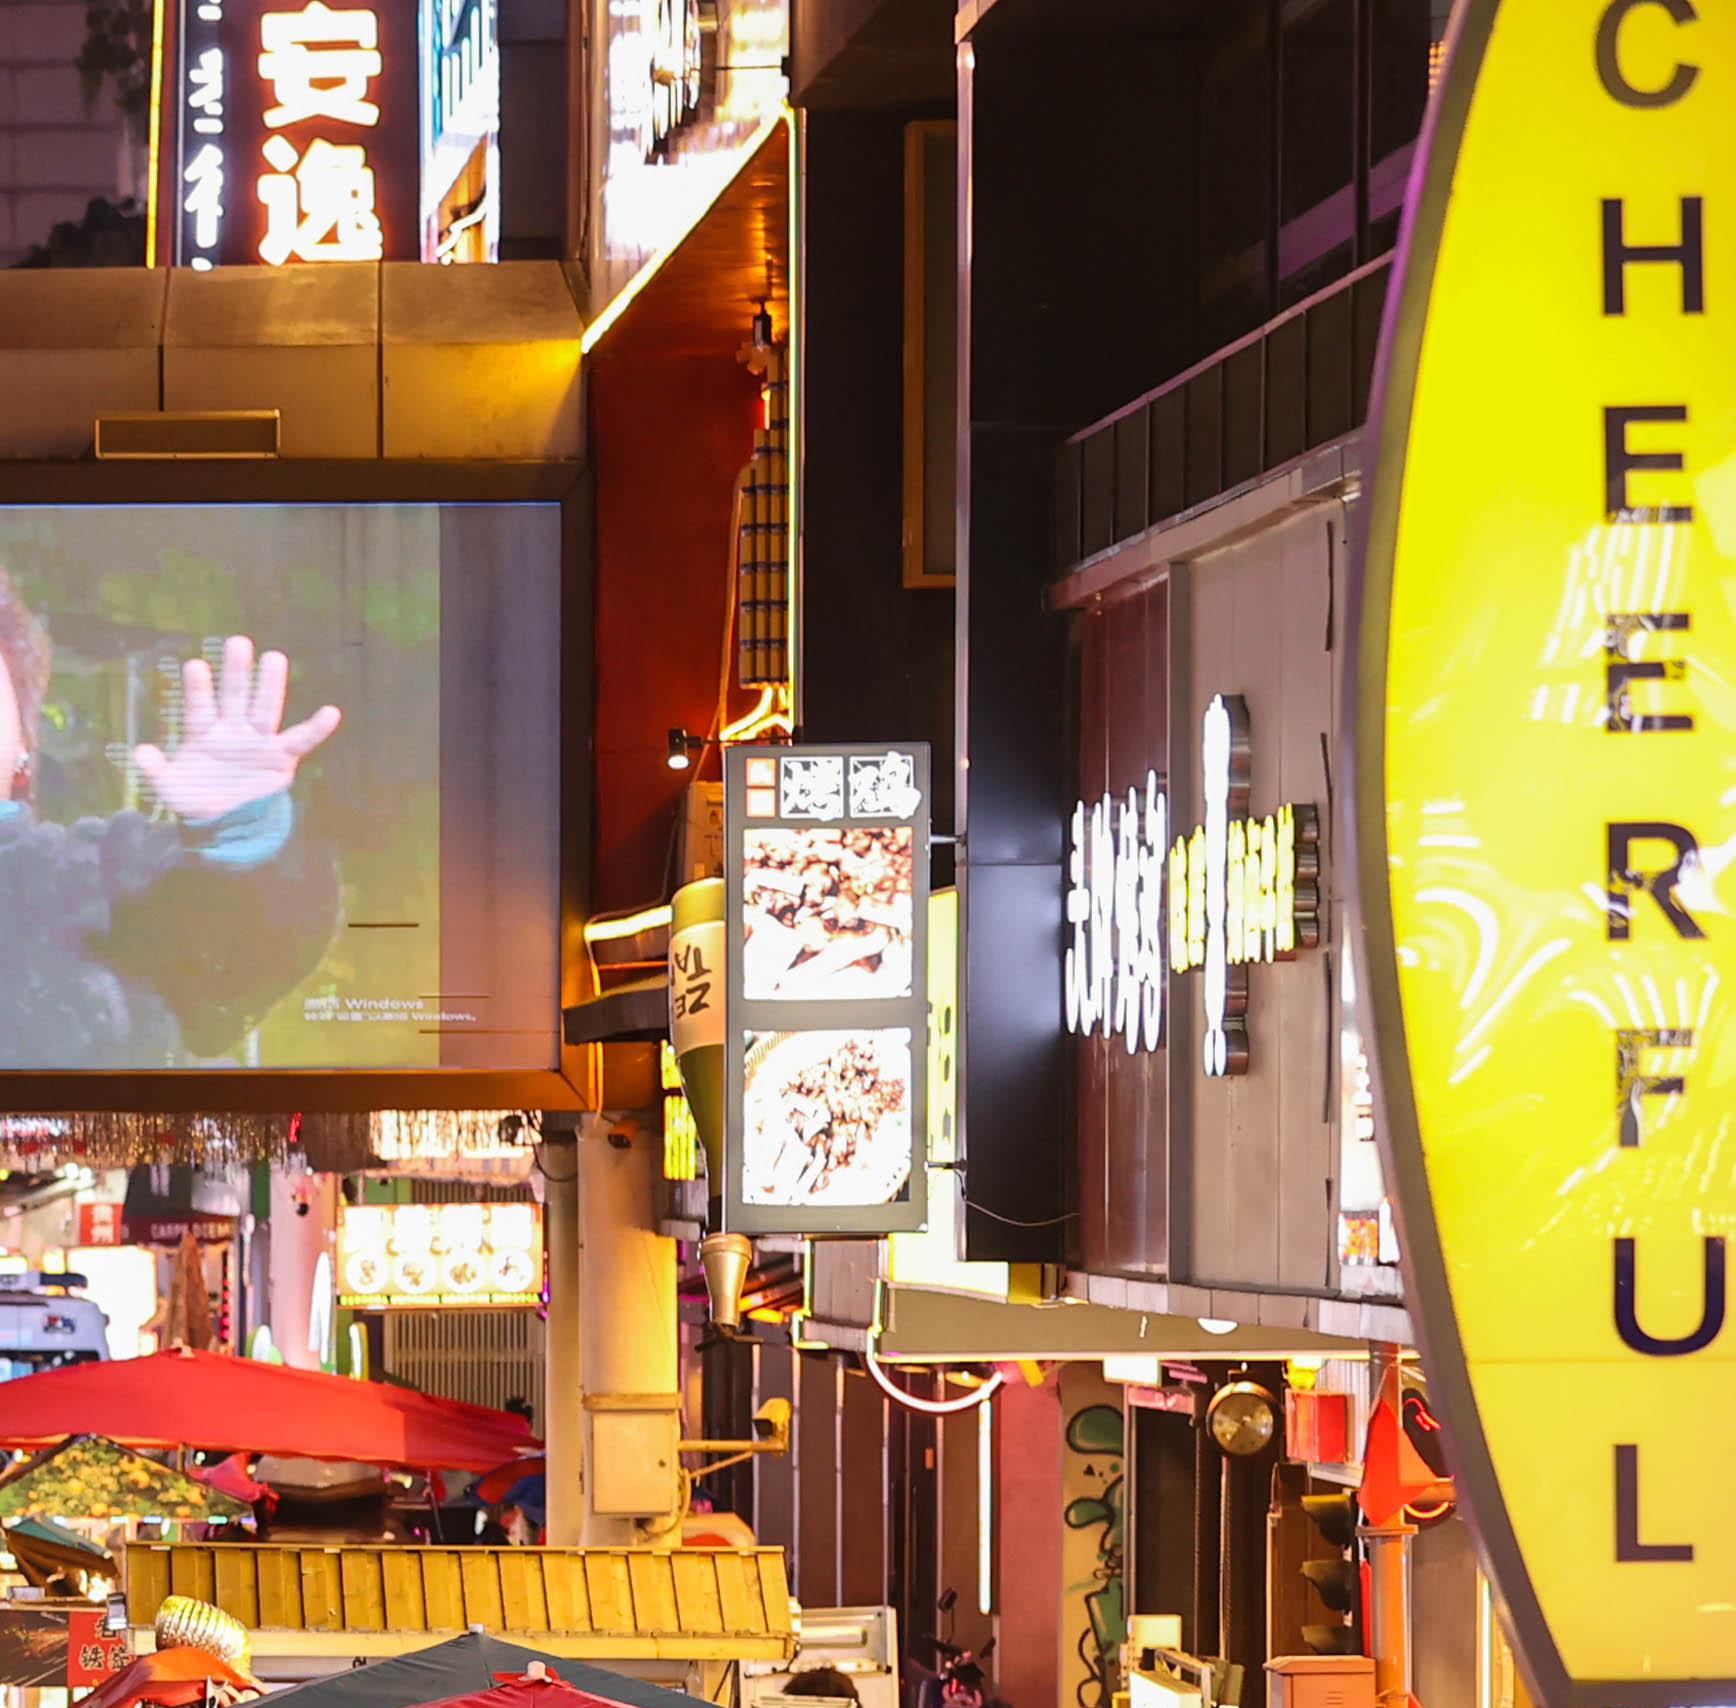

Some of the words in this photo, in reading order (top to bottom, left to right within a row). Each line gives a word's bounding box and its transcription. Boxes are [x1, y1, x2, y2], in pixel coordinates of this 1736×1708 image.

[257, 1, 383, 266] 安逸
[1594, 0, 1725, 1564] CHEERFUL
[345, 997, 425, 1010] Windows
